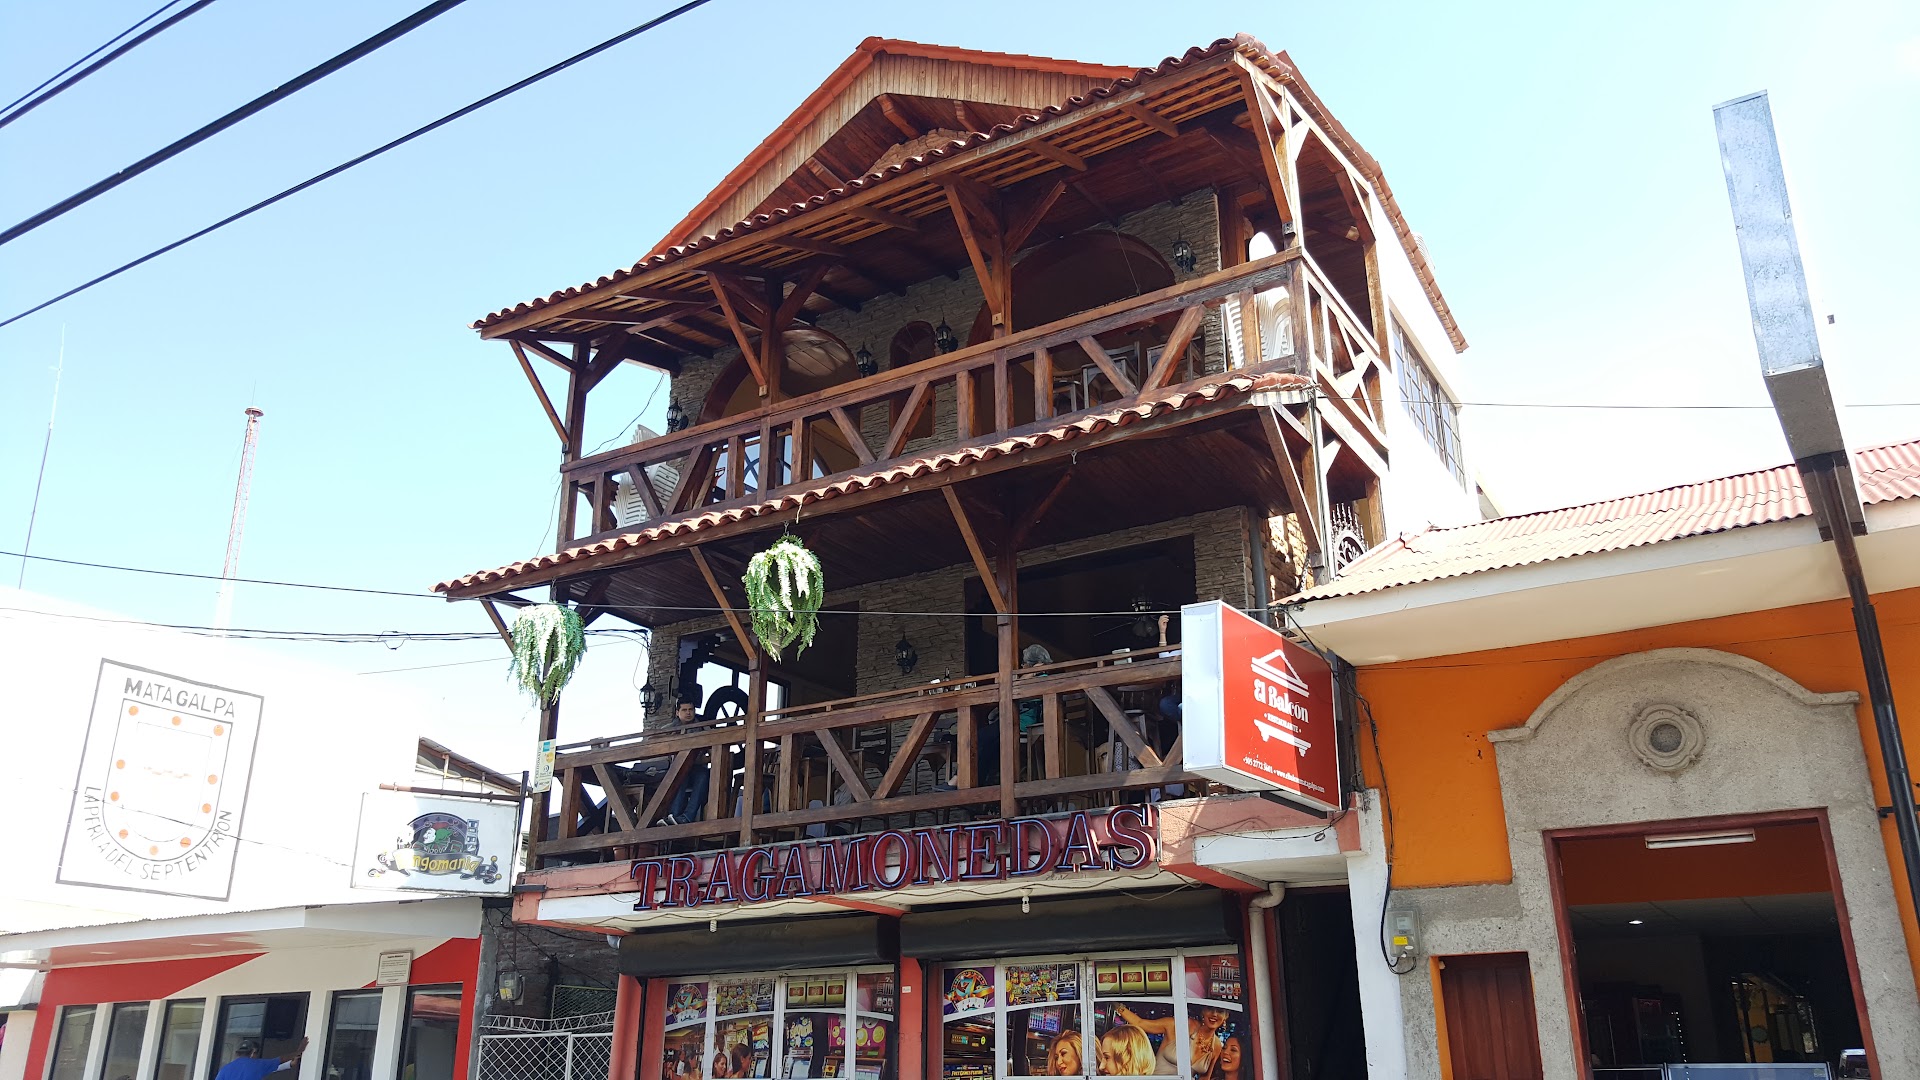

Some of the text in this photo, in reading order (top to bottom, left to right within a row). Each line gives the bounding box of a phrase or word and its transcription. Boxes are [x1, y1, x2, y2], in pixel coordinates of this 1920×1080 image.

[124, 677, 235, 718] MATAGALPA
[1253, 678, 1310, 724] El Balcón
[83, 786, 102, 802] LA
[105, 848, 133, 875] DEL
[411, 854, 481, 873] ngomania
[630, 803, 1159, 911] TRAGAMONEDAS
